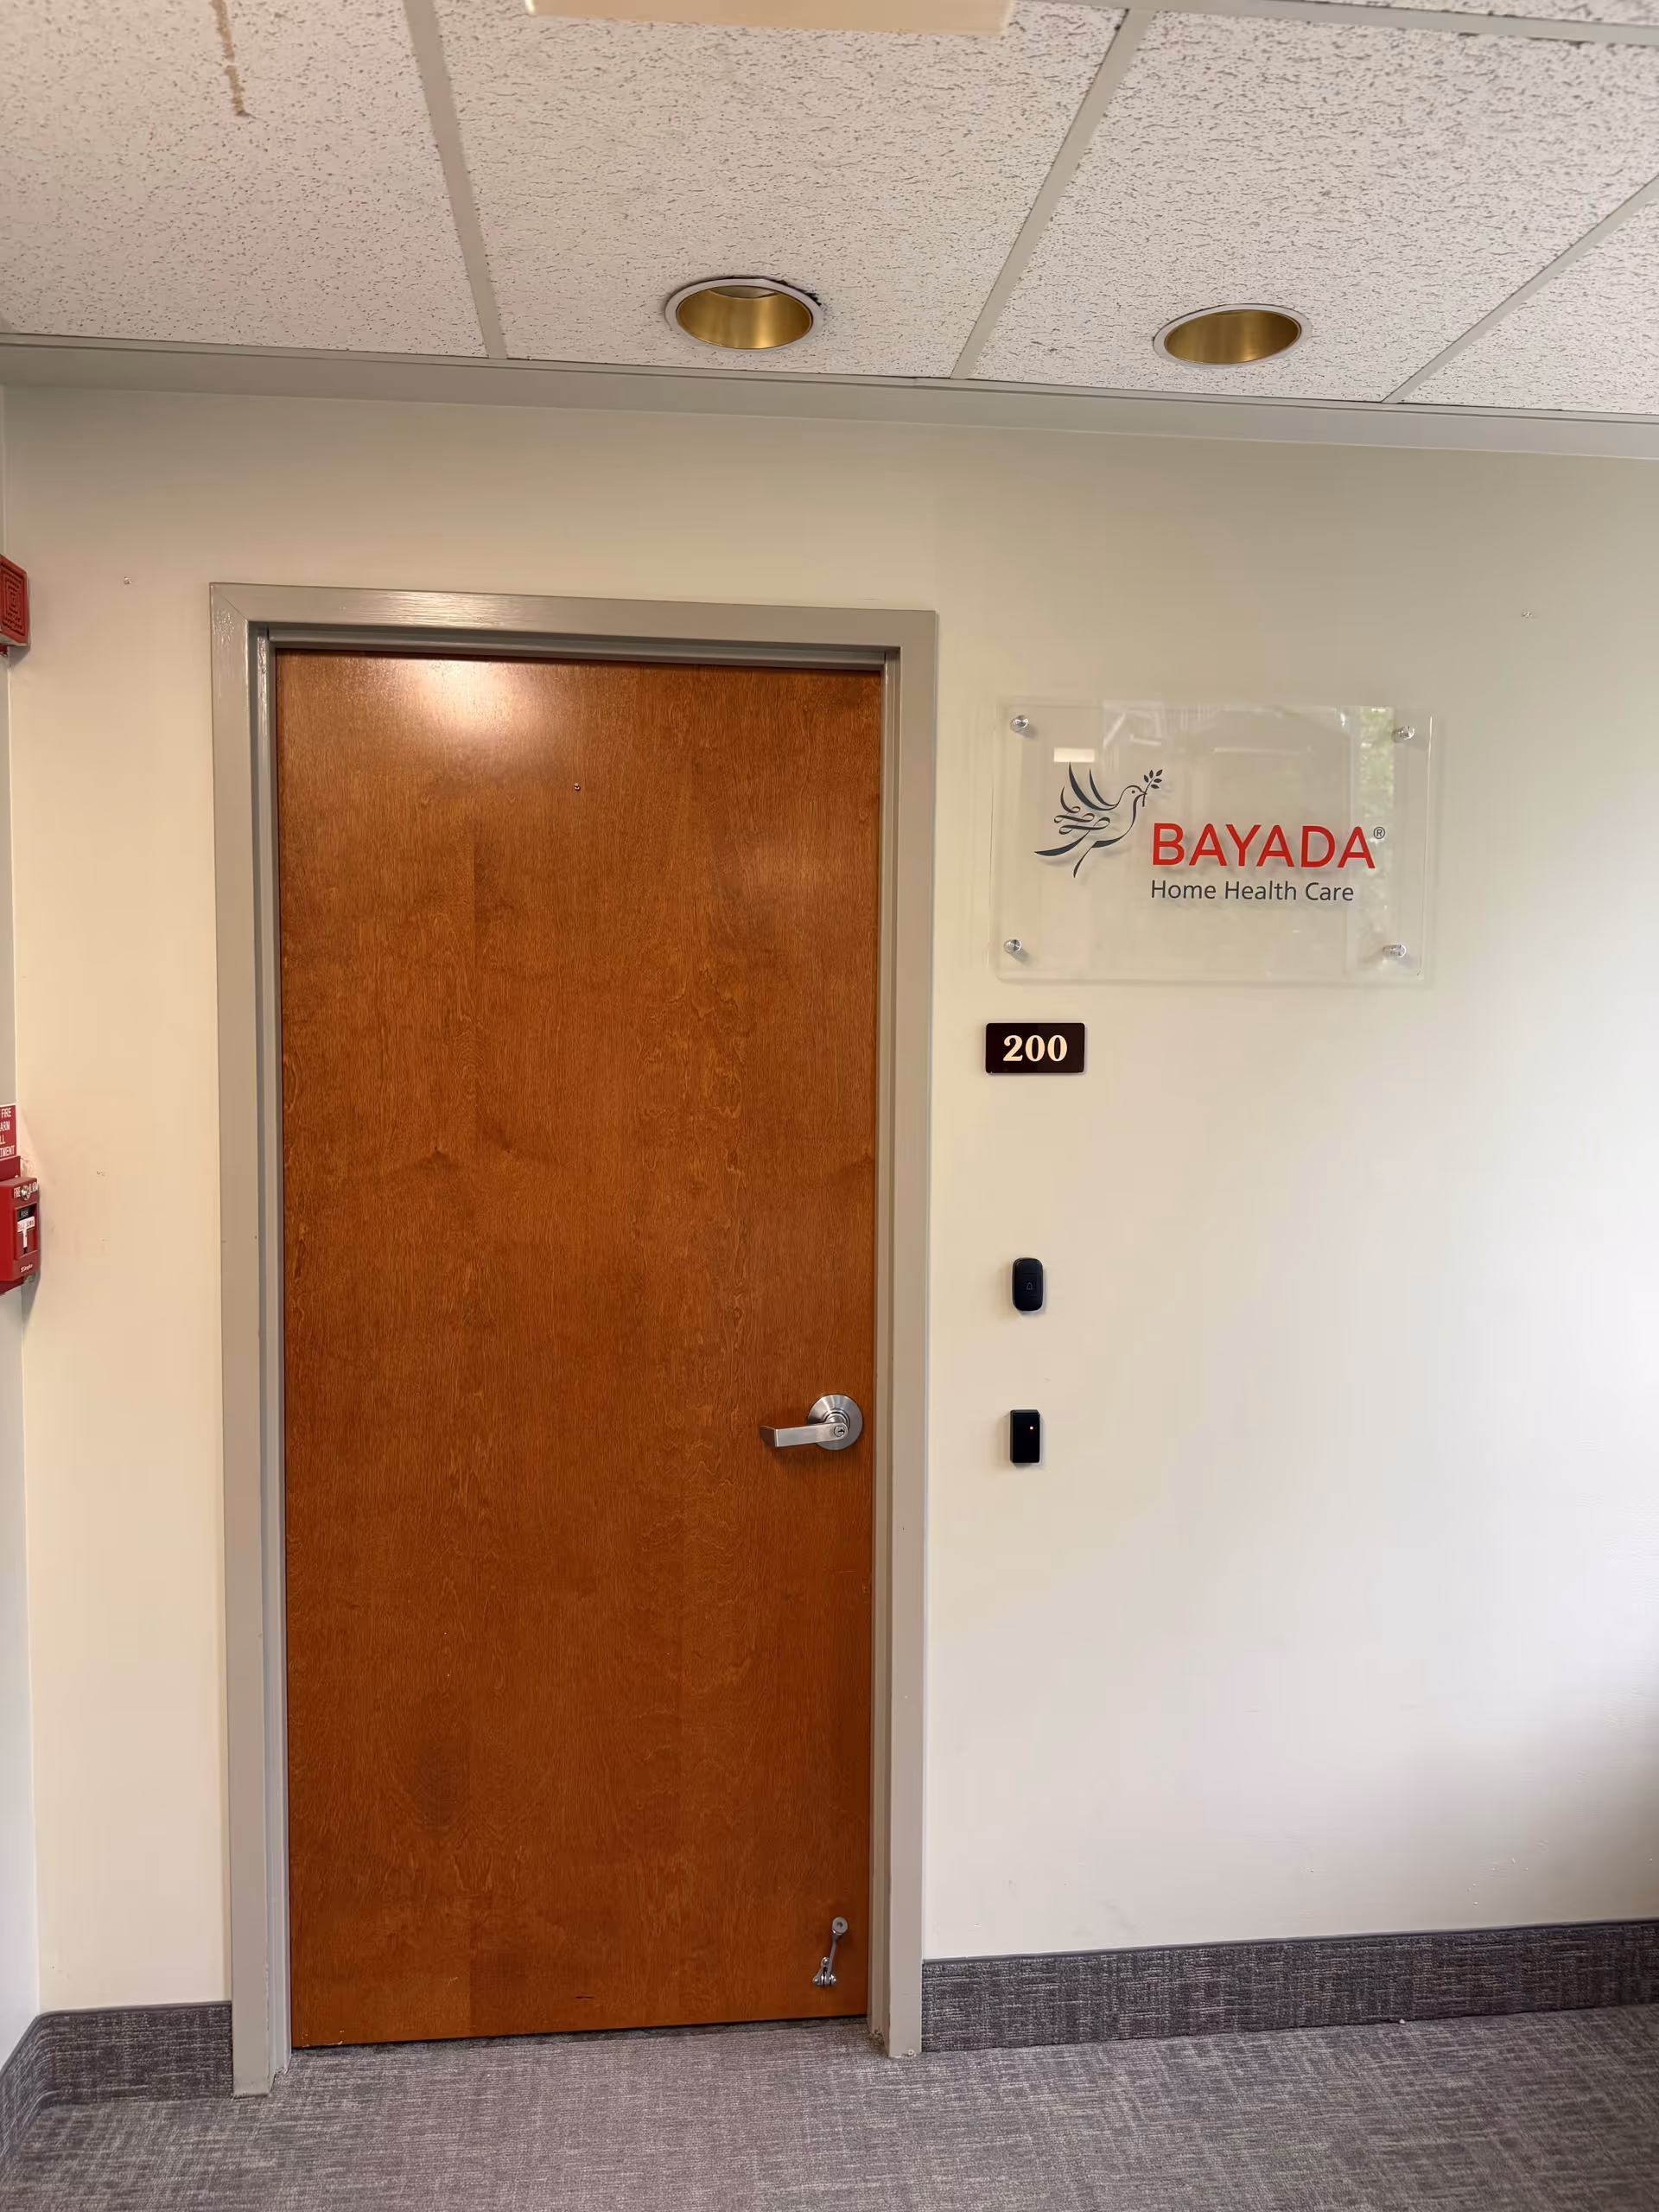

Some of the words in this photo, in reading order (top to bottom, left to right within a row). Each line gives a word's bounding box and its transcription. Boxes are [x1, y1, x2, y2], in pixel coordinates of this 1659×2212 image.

[1151, 880, 1217, 899] Home
[1224, 880, 1297, 900] Health
[1305, 881, 1354, 902] Care
[1002, 1034, 1068, 1062] 200
[1, 1107, 12, 1119] FIRE
[0, 1120, 10, 1132] ARM
